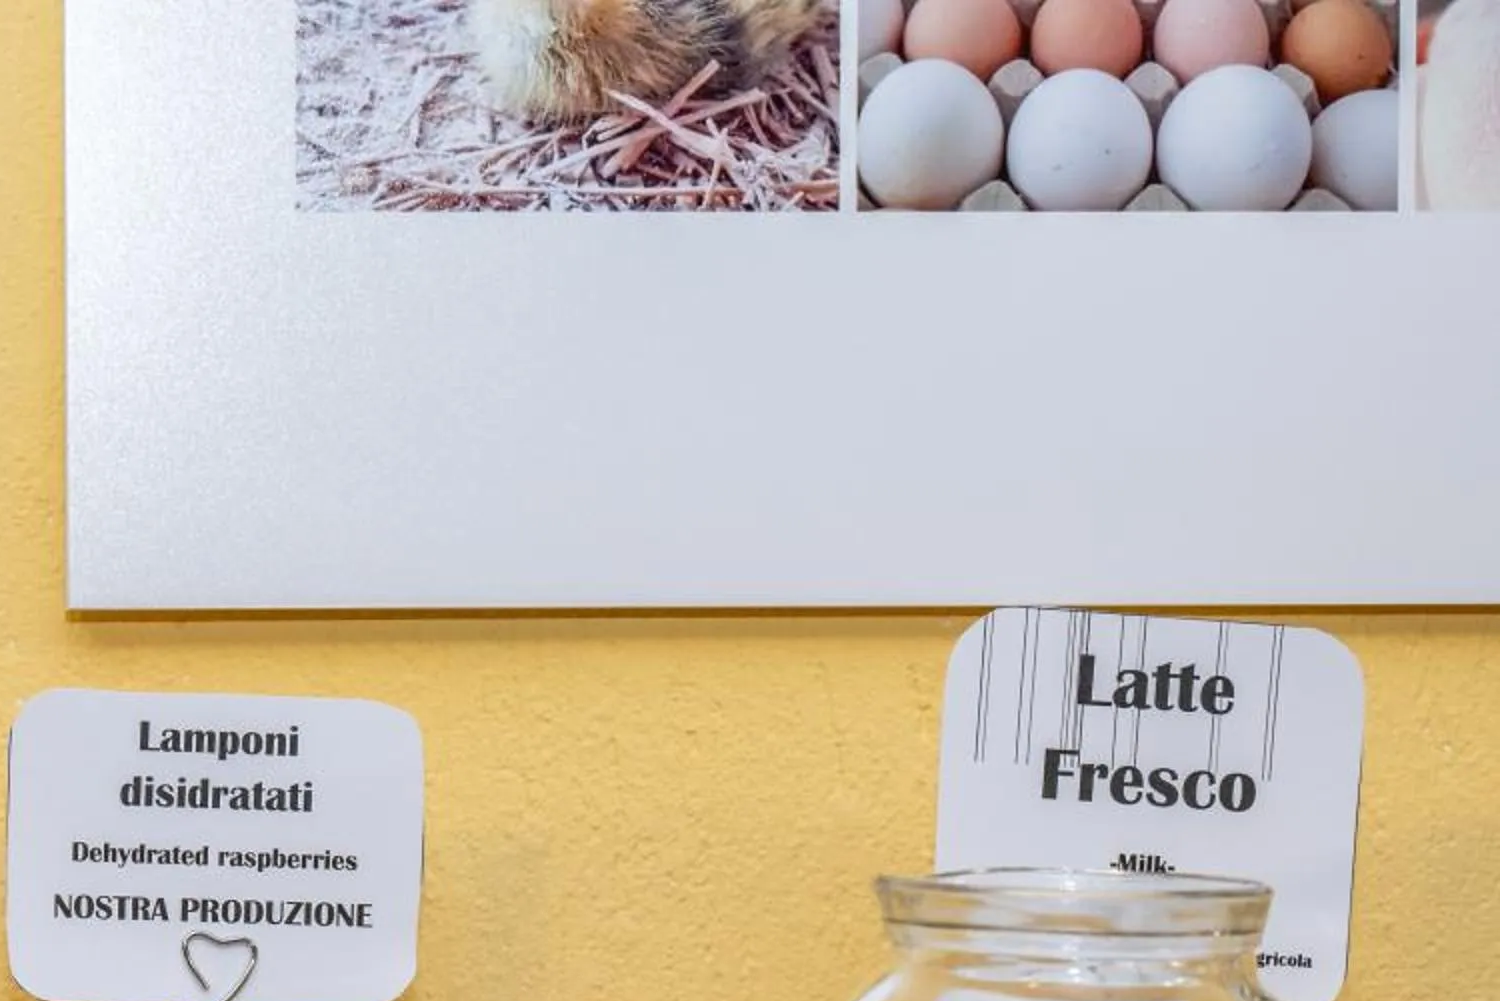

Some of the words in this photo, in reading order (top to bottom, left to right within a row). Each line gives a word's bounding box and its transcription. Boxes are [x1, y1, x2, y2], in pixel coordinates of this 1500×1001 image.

[1077, 654, 1235, 715] Latte
[139, 720, 299, 761] Lamponi
[119, 775, 313, 813] disidratati
[1041, 748, 1256, 812] Fresco
[71, 841, 209, 868] Dehydrated
[218, 847, 358, 873] raspberries
[53, 893, 169, 922] NOSTRA
[180, 897, 373, 928] PRODUZIONE
[1255, 950, 1313, 969] gricola
